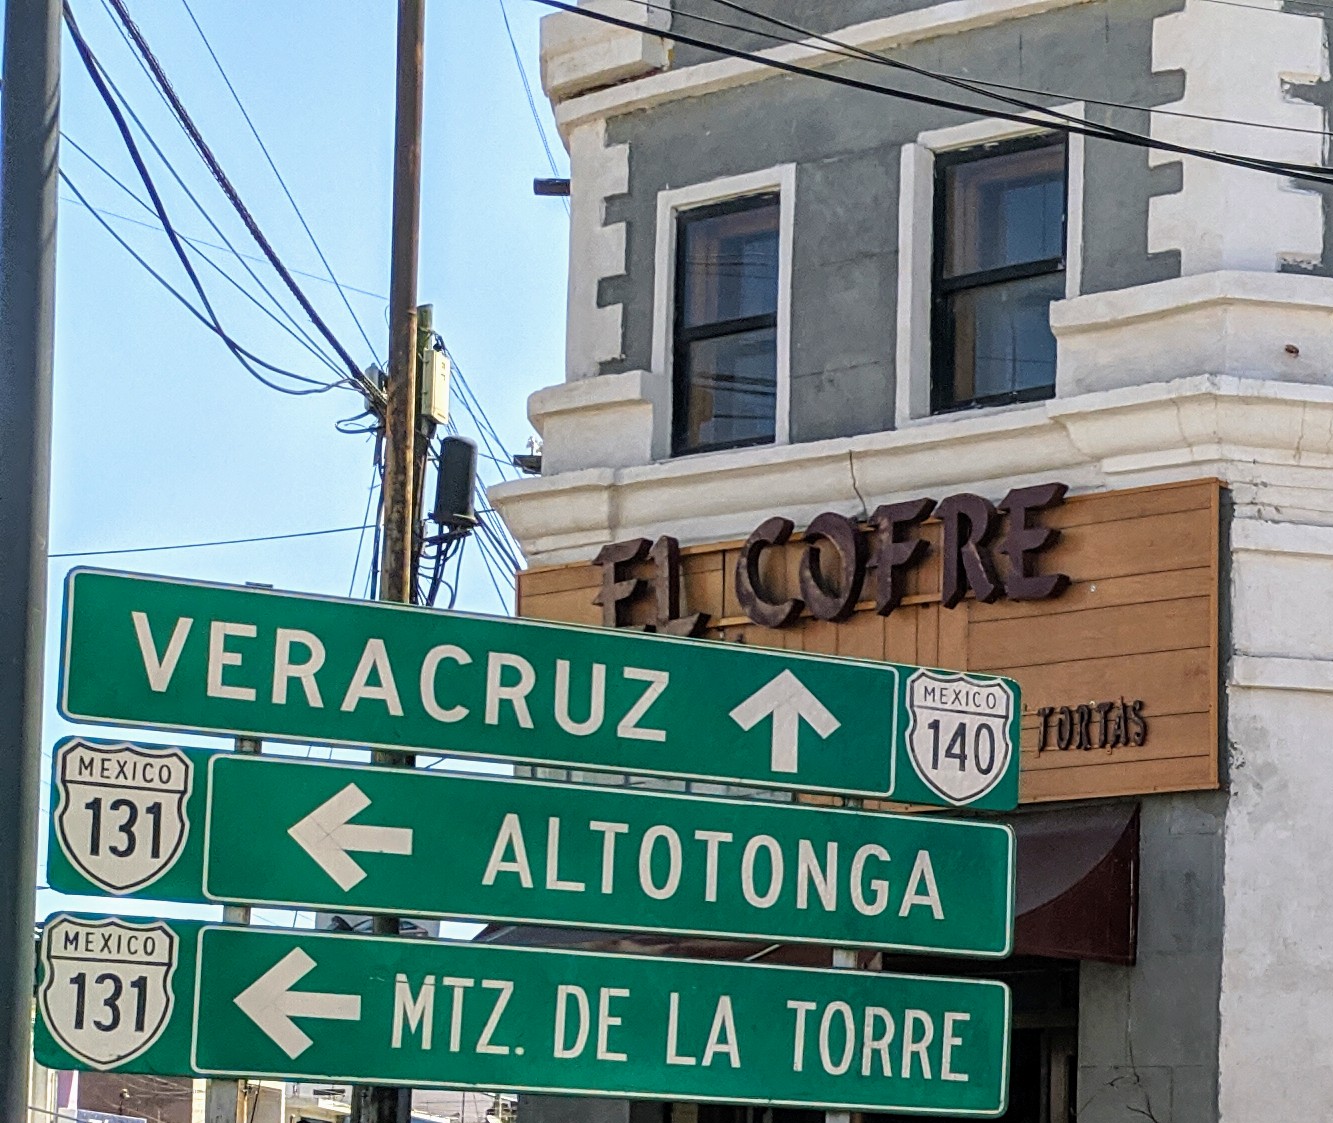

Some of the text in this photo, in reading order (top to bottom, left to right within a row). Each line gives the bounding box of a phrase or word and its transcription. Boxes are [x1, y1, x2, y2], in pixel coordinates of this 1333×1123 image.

[593, 482, 1071, 637] EL COFRE
[131, 611, 670, 742] VERACRUZ
[924, 685, 997, 709] MEXICO
[927, 719, 996, 776] 140
[1036, 697, 1147, 751] TORTAS
[78, 755, 172, 784] MEXICO
[84, 797, 163, 859] 131
[482, 813, 945, 920] ALTOTONGA
[64, 930, 156, 956] MEXICO
[69, 972, 148, 1032] 131
[391, 972, 970, 1083] MTZ. DE LA TORRE
